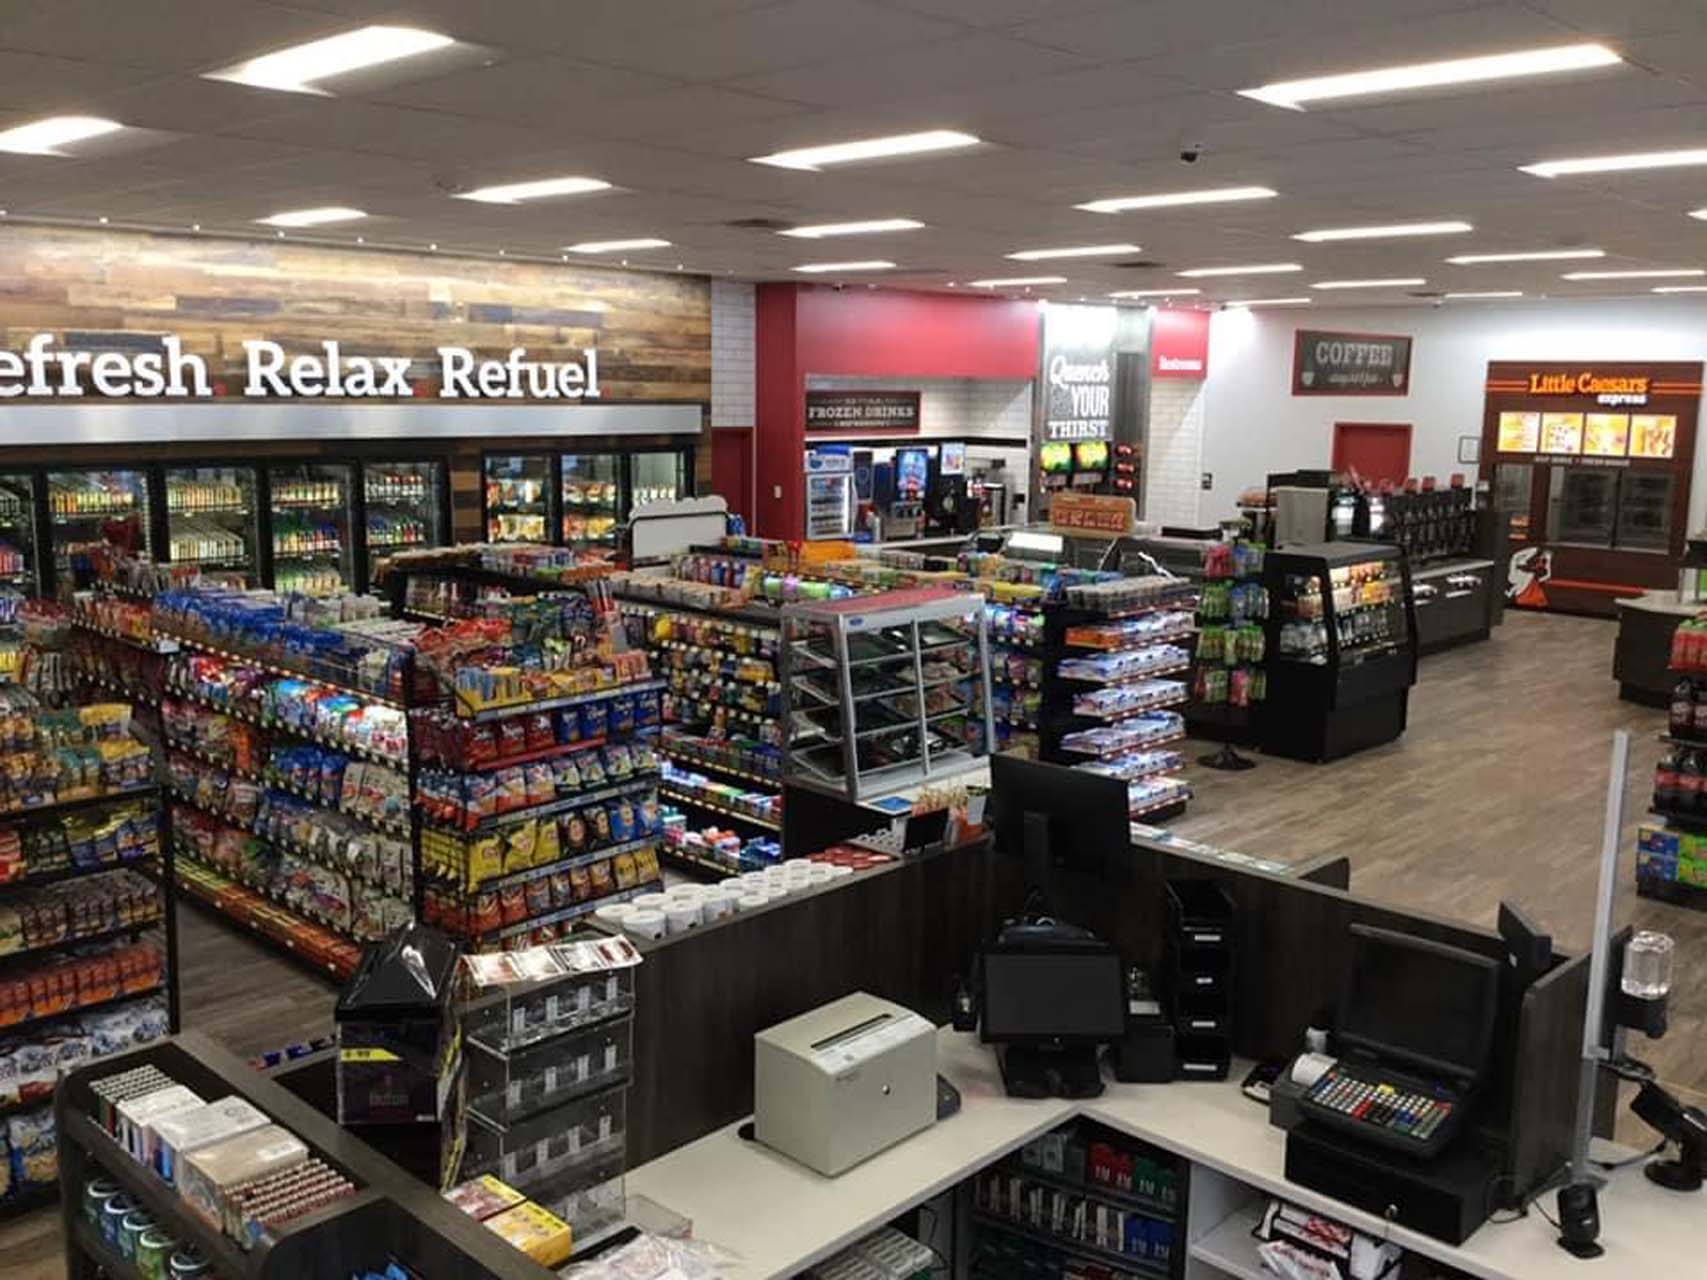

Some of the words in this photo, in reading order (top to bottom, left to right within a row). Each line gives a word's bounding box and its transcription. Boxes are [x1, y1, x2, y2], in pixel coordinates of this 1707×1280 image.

[1315, 342, 1393, 367] COFFEE
[1530, 373, 1576, 393] Little
[1578, 373, 1648, 394] Caesars
[1071, 385, 1110, 417] YOUR
[809, 406, 862, 419] FROZEN
[1048, 419, 1110, 439] THIRST
